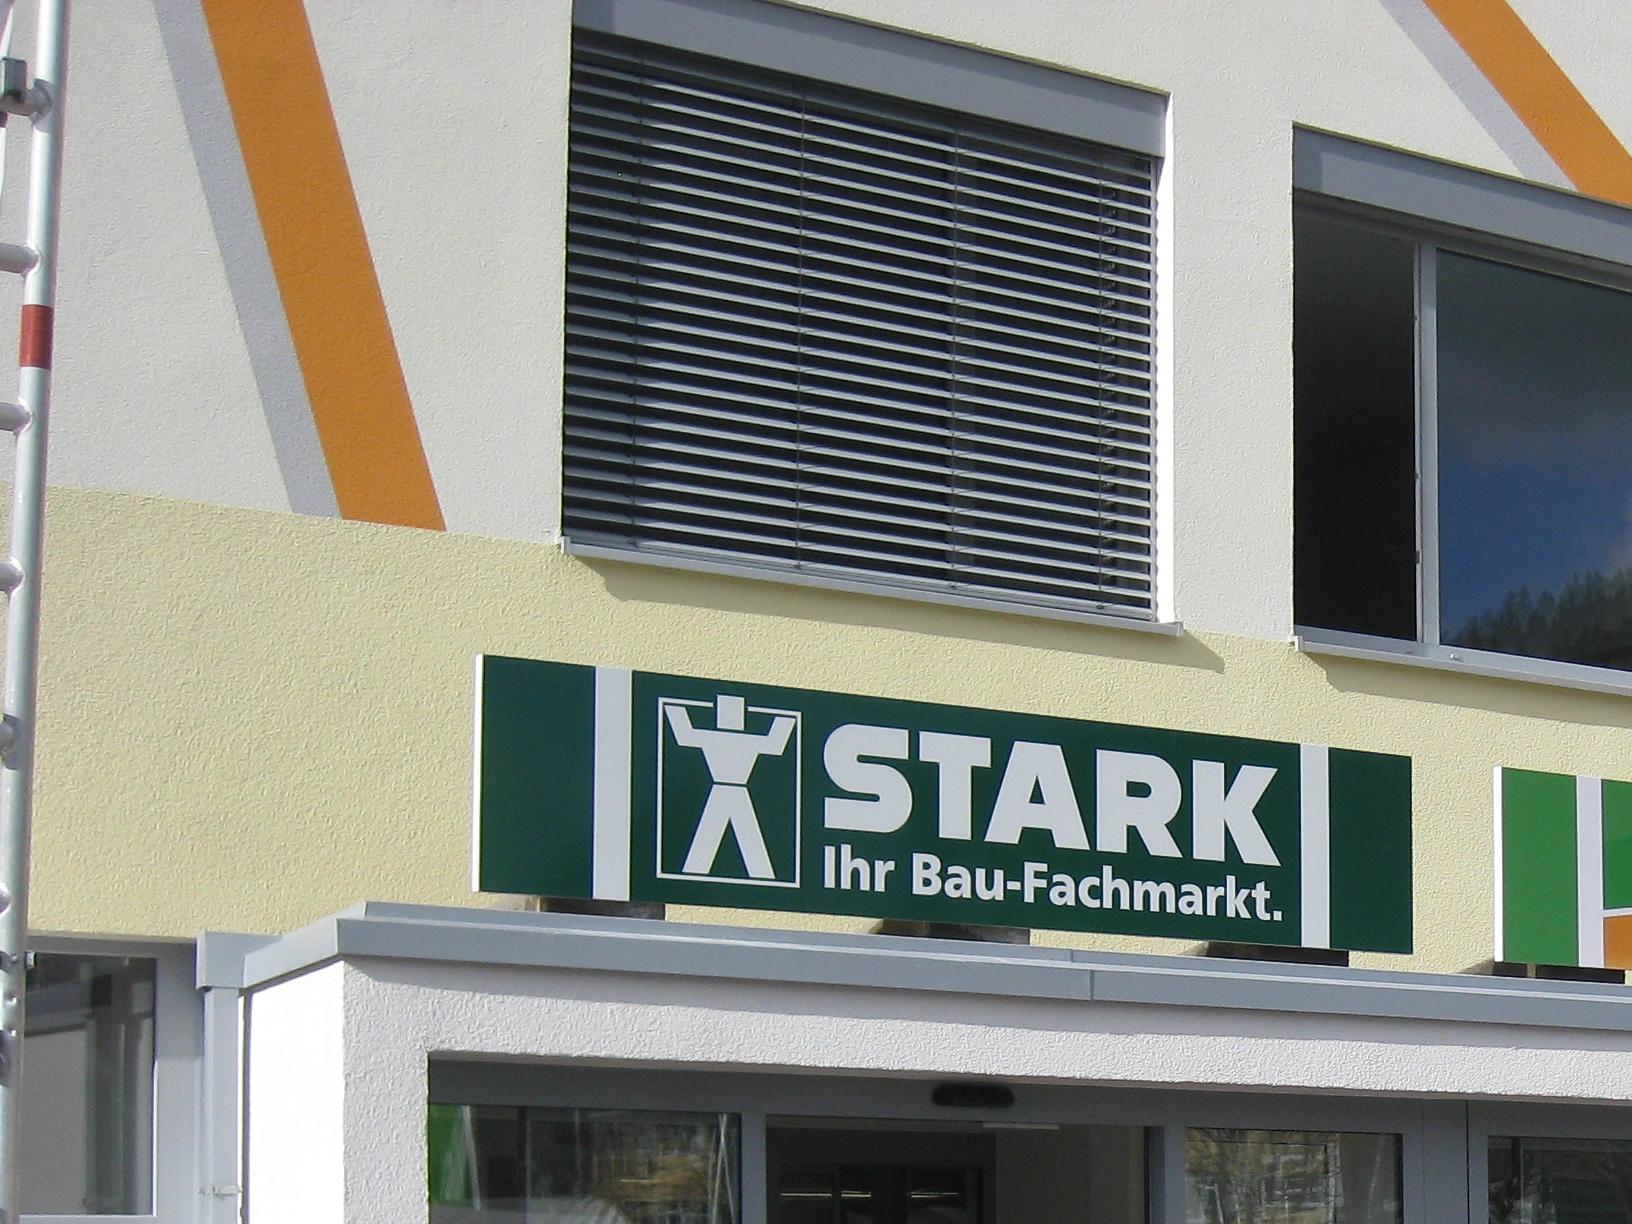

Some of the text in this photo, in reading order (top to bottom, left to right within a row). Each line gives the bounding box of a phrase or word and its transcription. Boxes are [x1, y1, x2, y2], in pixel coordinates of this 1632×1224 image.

[823, 723, 1282, 867] STARK
[823, 844, 1284, 922] Ihr Bau-Fachmarkt.
